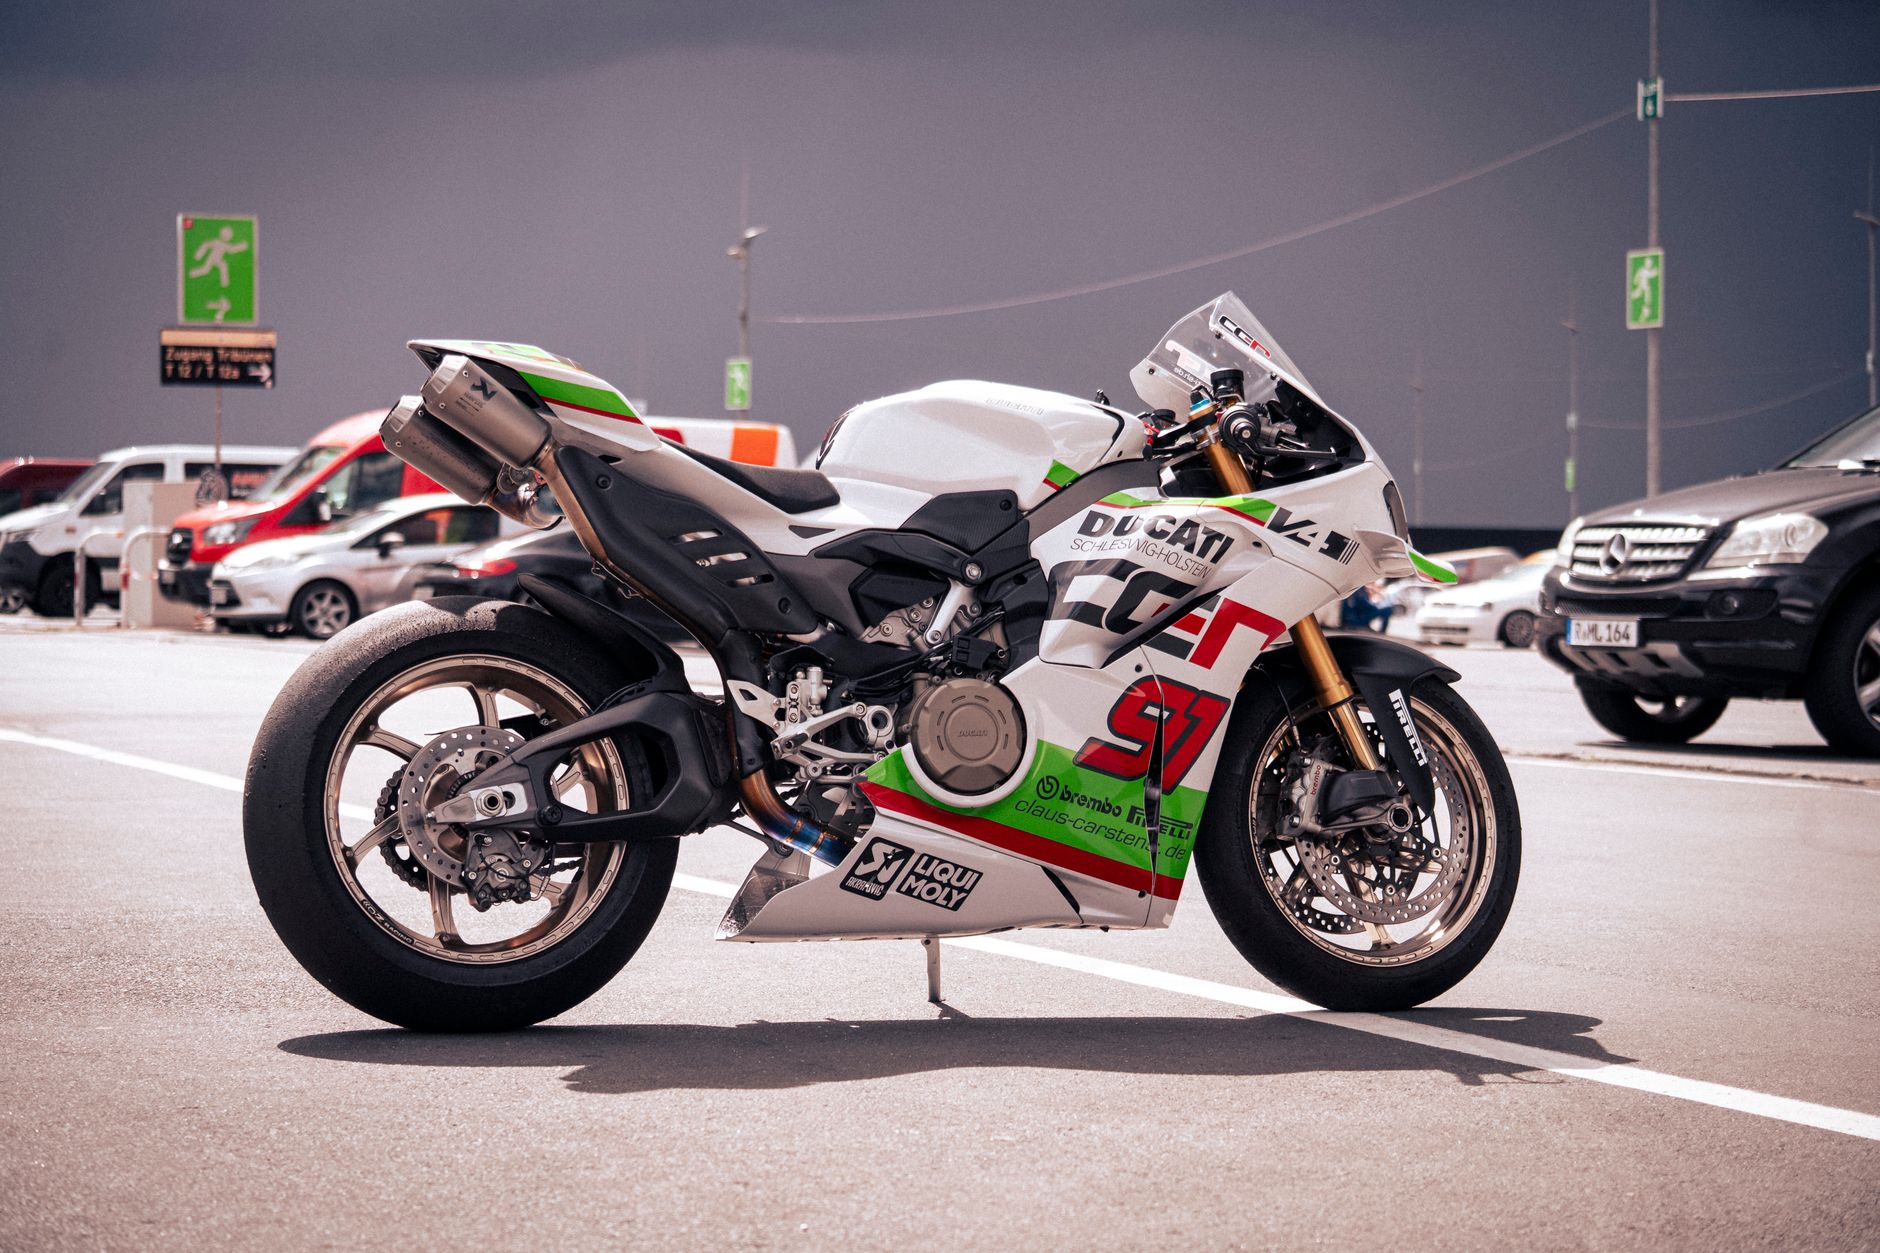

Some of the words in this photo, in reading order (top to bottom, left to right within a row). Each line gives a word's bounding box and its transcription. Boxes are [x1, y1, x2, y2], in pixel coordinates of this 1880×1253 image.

[1077, 510, 1234, 565] DUCATI
[1070, 538, 1212, 580] SCHLESWIG-HOLSTEIN
[1606, 623, 1630, 642] 164
[1073, 674, 1231, 796] 91
[1388, 689, 1428, 767] PIRELLI
[1310, 764, 1321, 796] brembo
[1060, 784, 1122, 817] brembo
[913, 855, 979, 890] LIQUI
[901, 874, 968, 908] MOLY
